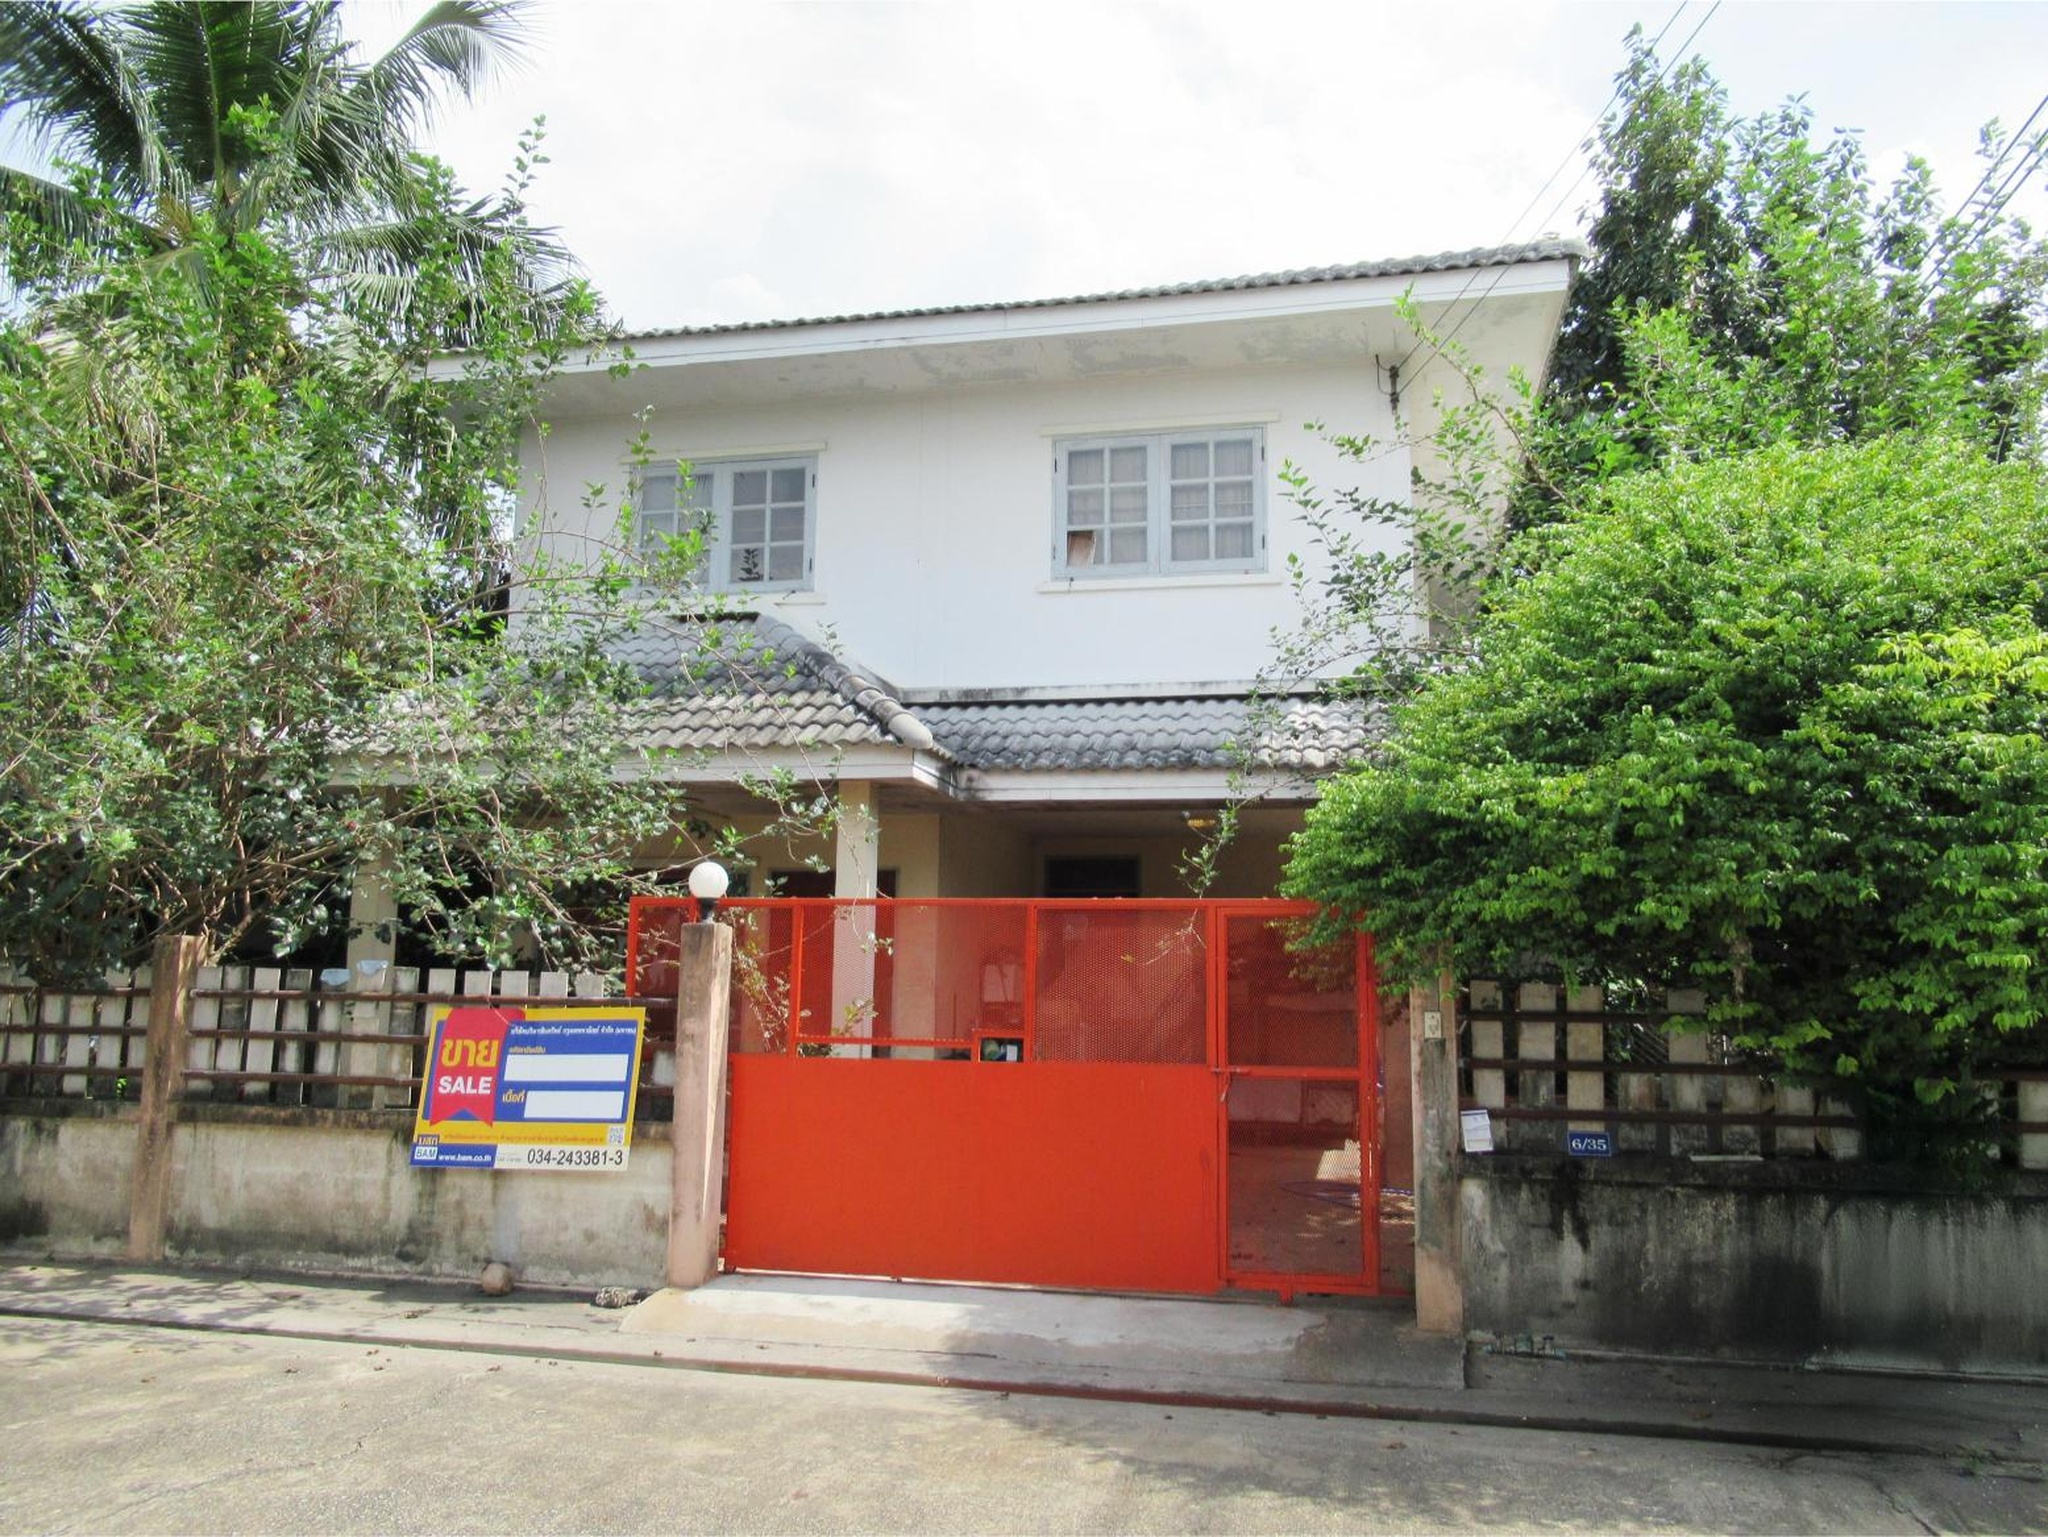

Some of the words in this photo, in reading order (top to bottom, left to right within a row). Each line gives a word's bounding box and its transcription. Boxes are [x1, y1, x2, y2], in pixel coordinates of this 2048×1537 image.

[441, 1038, 499, 1068] ขาย
[438, 1076, 492, 1095] SALE
[1572, 1138, 1607, 1151] 6/35
[416, 1147, 437, 1158] BAM
[438, 1153, 492, 1162] www.bam.co.th
[527, 1148, 623, 1166] 034-243381-3
